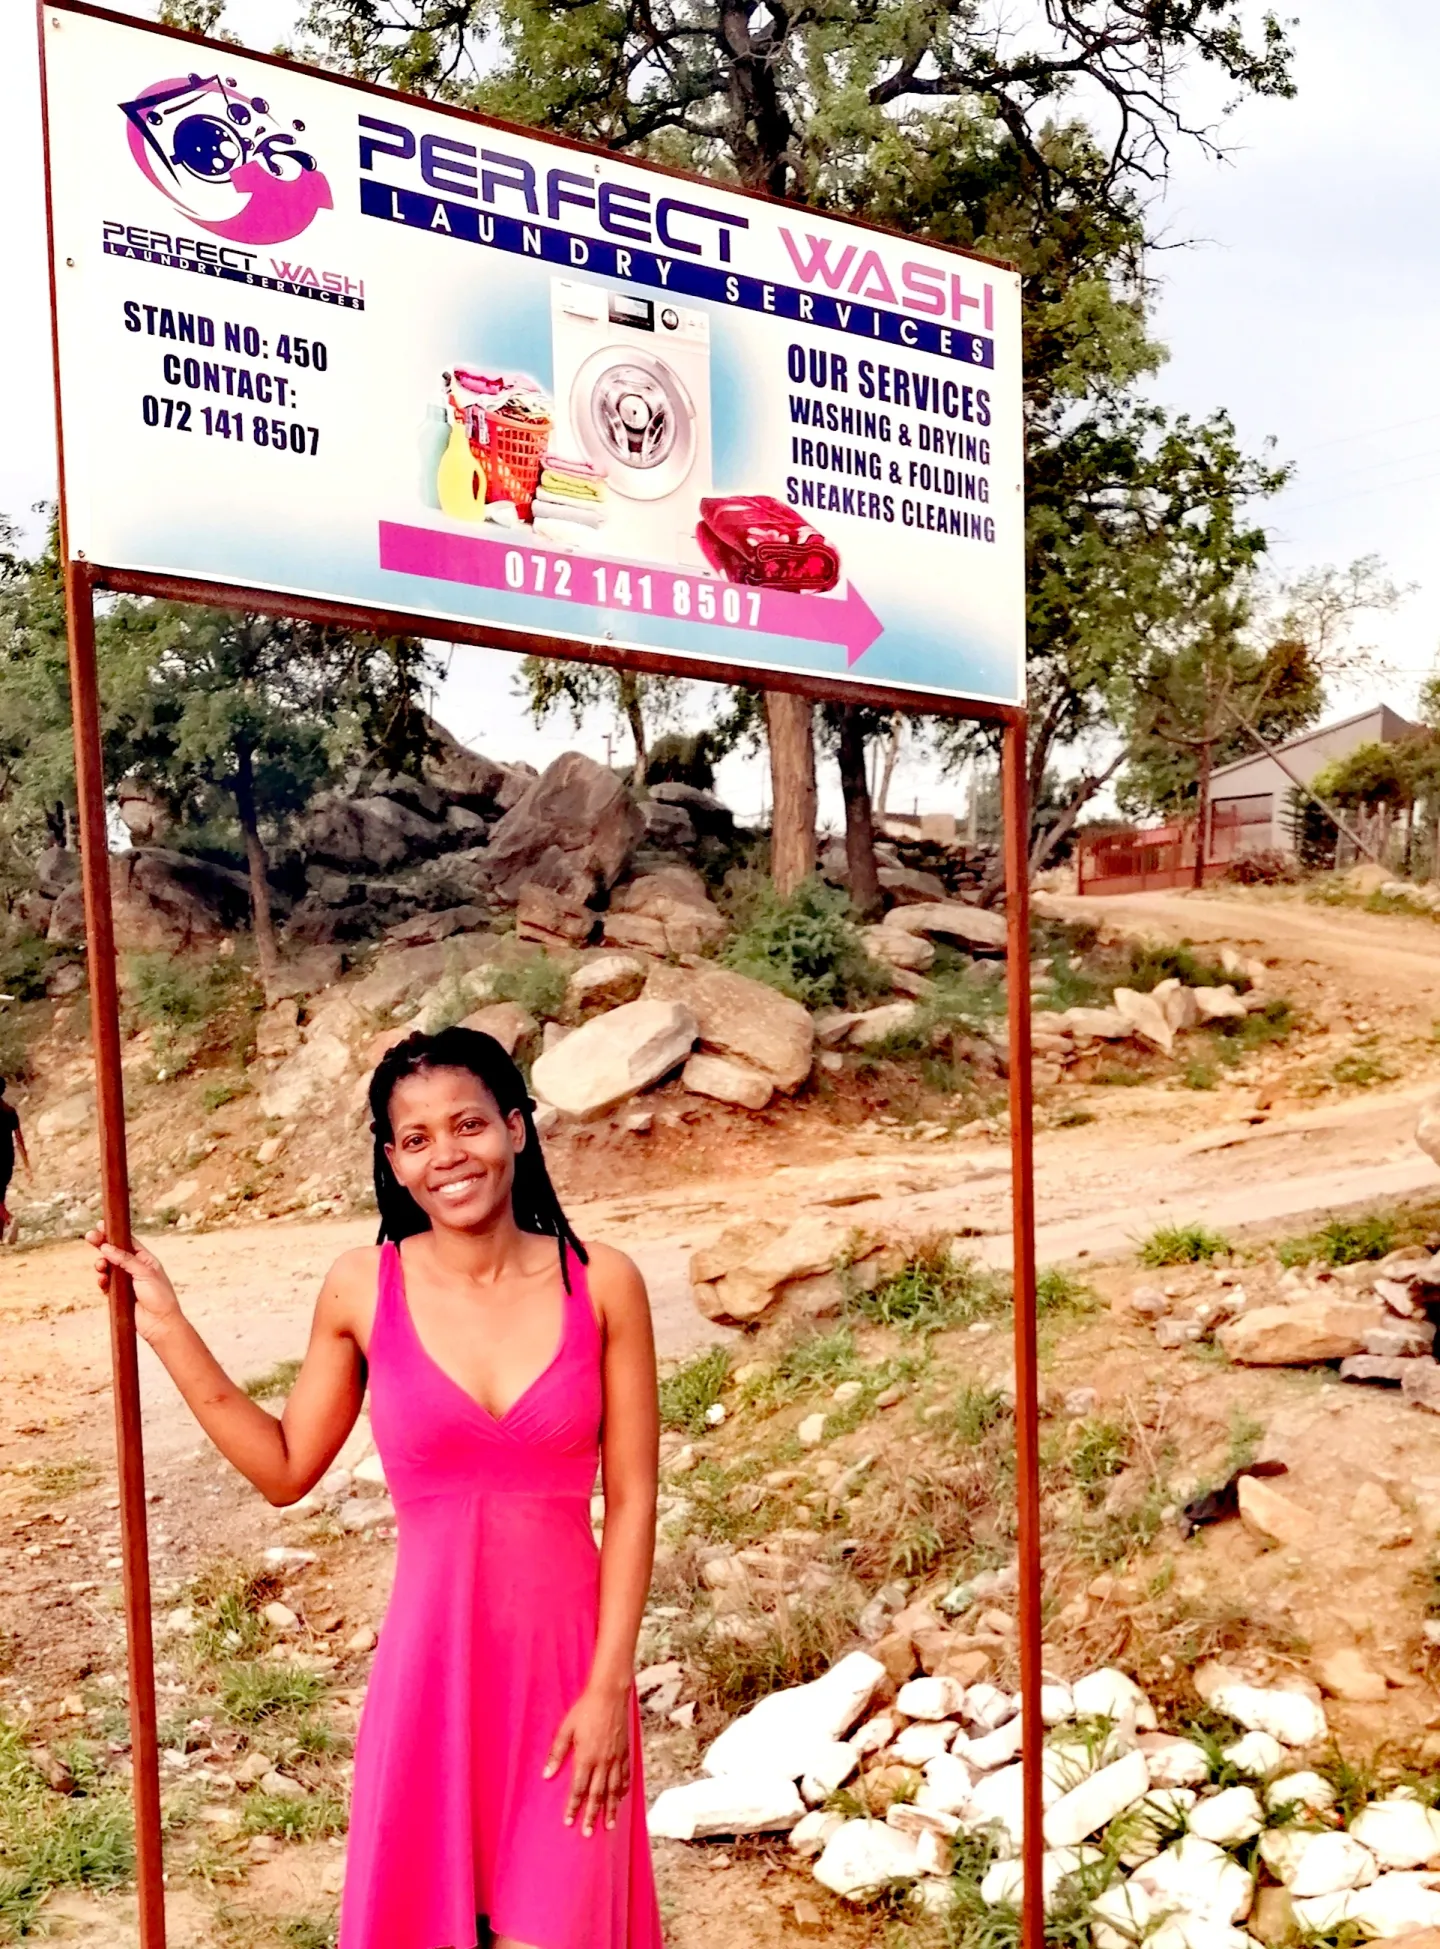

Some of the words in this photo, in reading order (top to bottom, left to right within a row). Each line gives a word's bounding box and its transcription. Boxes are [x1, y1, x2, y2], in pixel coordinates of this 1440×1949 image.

[358, 114, 749, 263] PERFECT
[777, 226, 994, 331] WASH
[103, 220, 257, 271] PERFECT
[270, 258, 365, 297] WASH
[110, 244, 222, 277] LAUNDRY
[246, 274, 360, 309] SERVICES
[391, 191, 672, 285] LAUNDRY
[726, 276, 983, 363] SERVICES
[123, 300, 215, 347] STAND
[224, 321, 269, 359] NO:
[276, 334, 327, 372] 450
[163, 354, 297, 409] CONTACT:
[787, 343, 848, 393] OUR
[858, 360, 991, 427] SERVICES
[142, 395, 192, 432] 072
[200, 406, 244, 442] 141
[252, 416, 319, 456] 8507
[789, 394, 891, 442] WASHING
[898, 424, 912, 447] &
[919, 424, 990, 465] DRYING
[792, 436, 882, 480] IRONING
[889, 461, 902, 485] &
[909, 461, 989, 504] FOLDING
[786, 476, 895, 523] SNEAKERS
[902, 499, 995, 543] CLEANING
[505, 551, 572, 596] 072
[592, 567, 653, 610] 141
[673, 580, 761, 627] 8507
